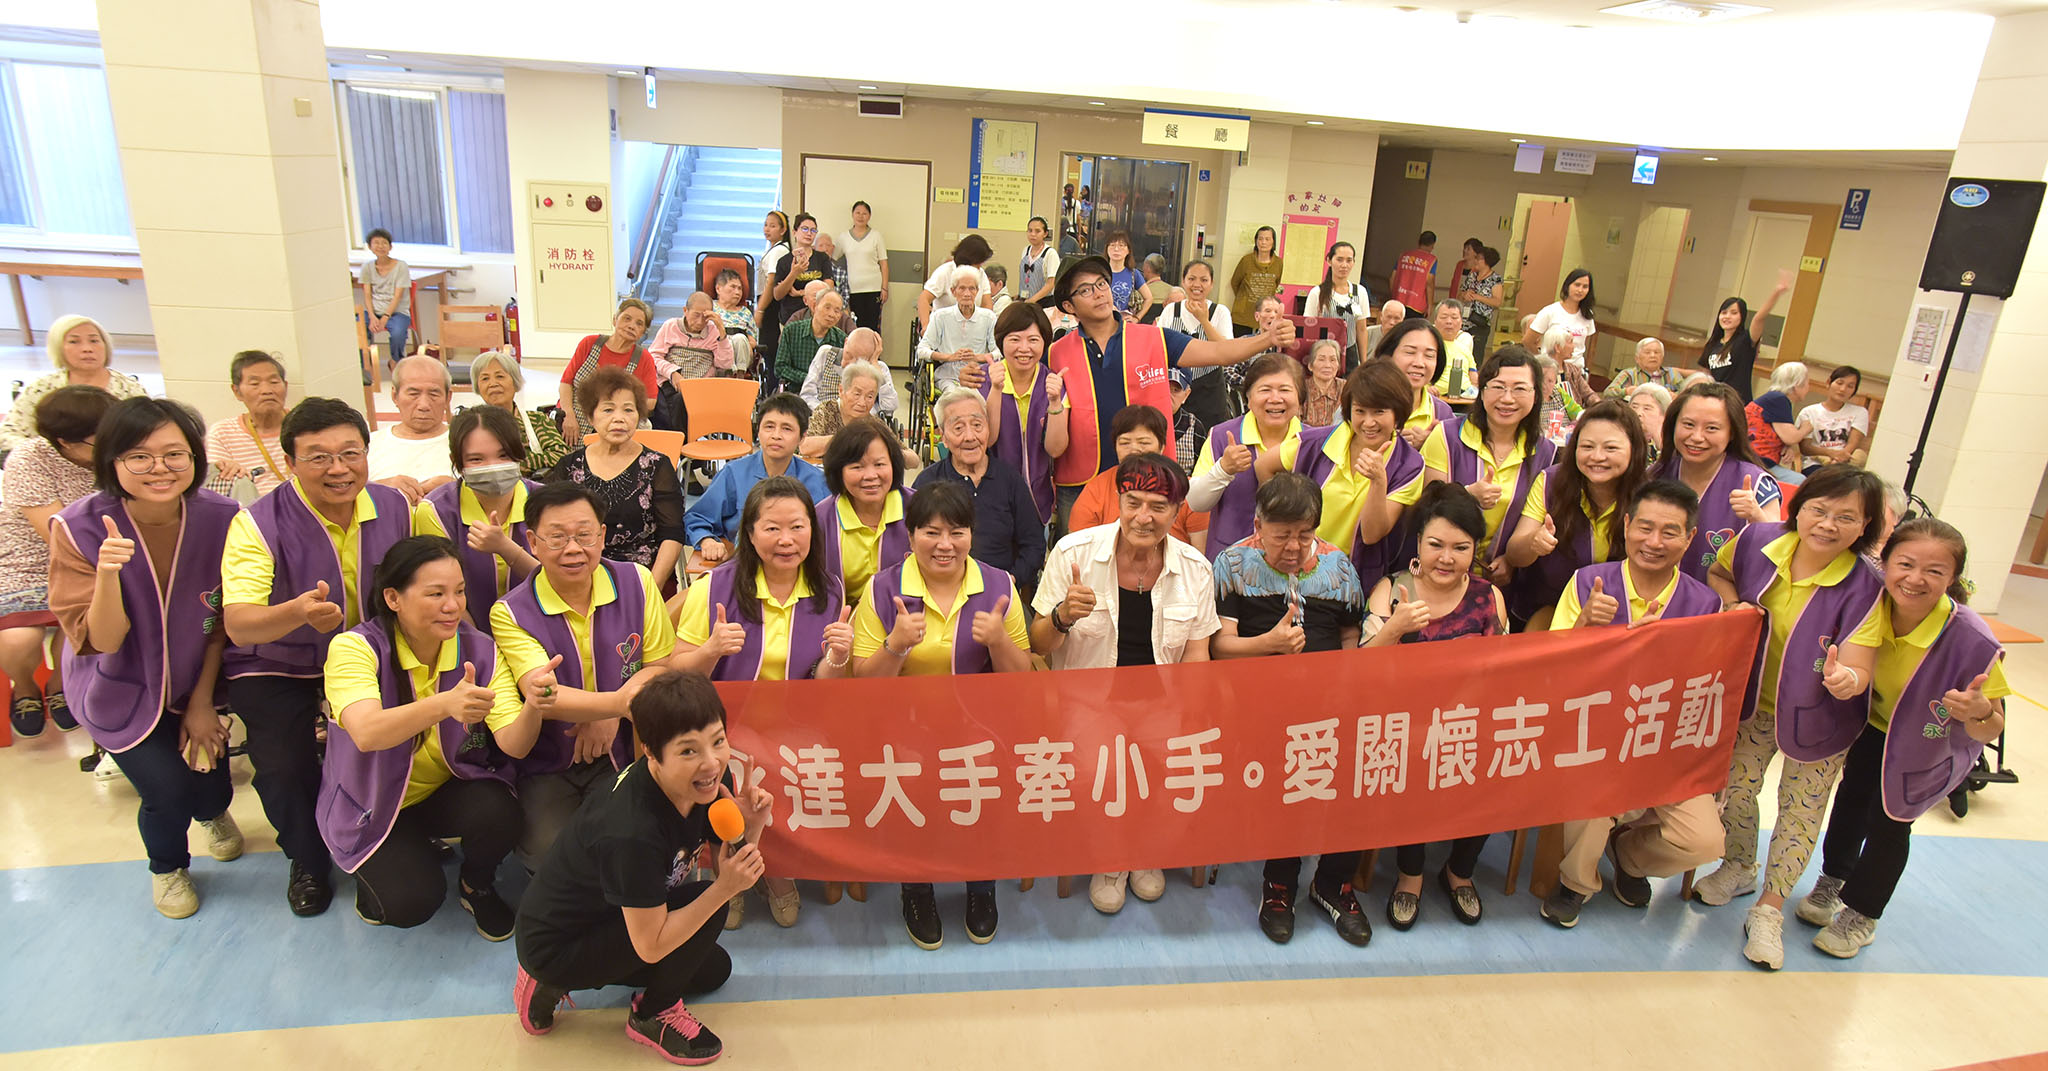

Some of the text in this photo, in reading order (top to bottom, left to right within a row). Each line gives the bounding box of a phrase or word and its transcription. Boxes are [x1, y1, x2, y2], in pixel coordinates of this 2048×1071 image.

[1164, 123, 1229, 143] 餐廳
[1850, 190, 1864, 208] P
[547, 247, 595, 261] 消防栓
[549, 262, 595, 271] HYDRANT
